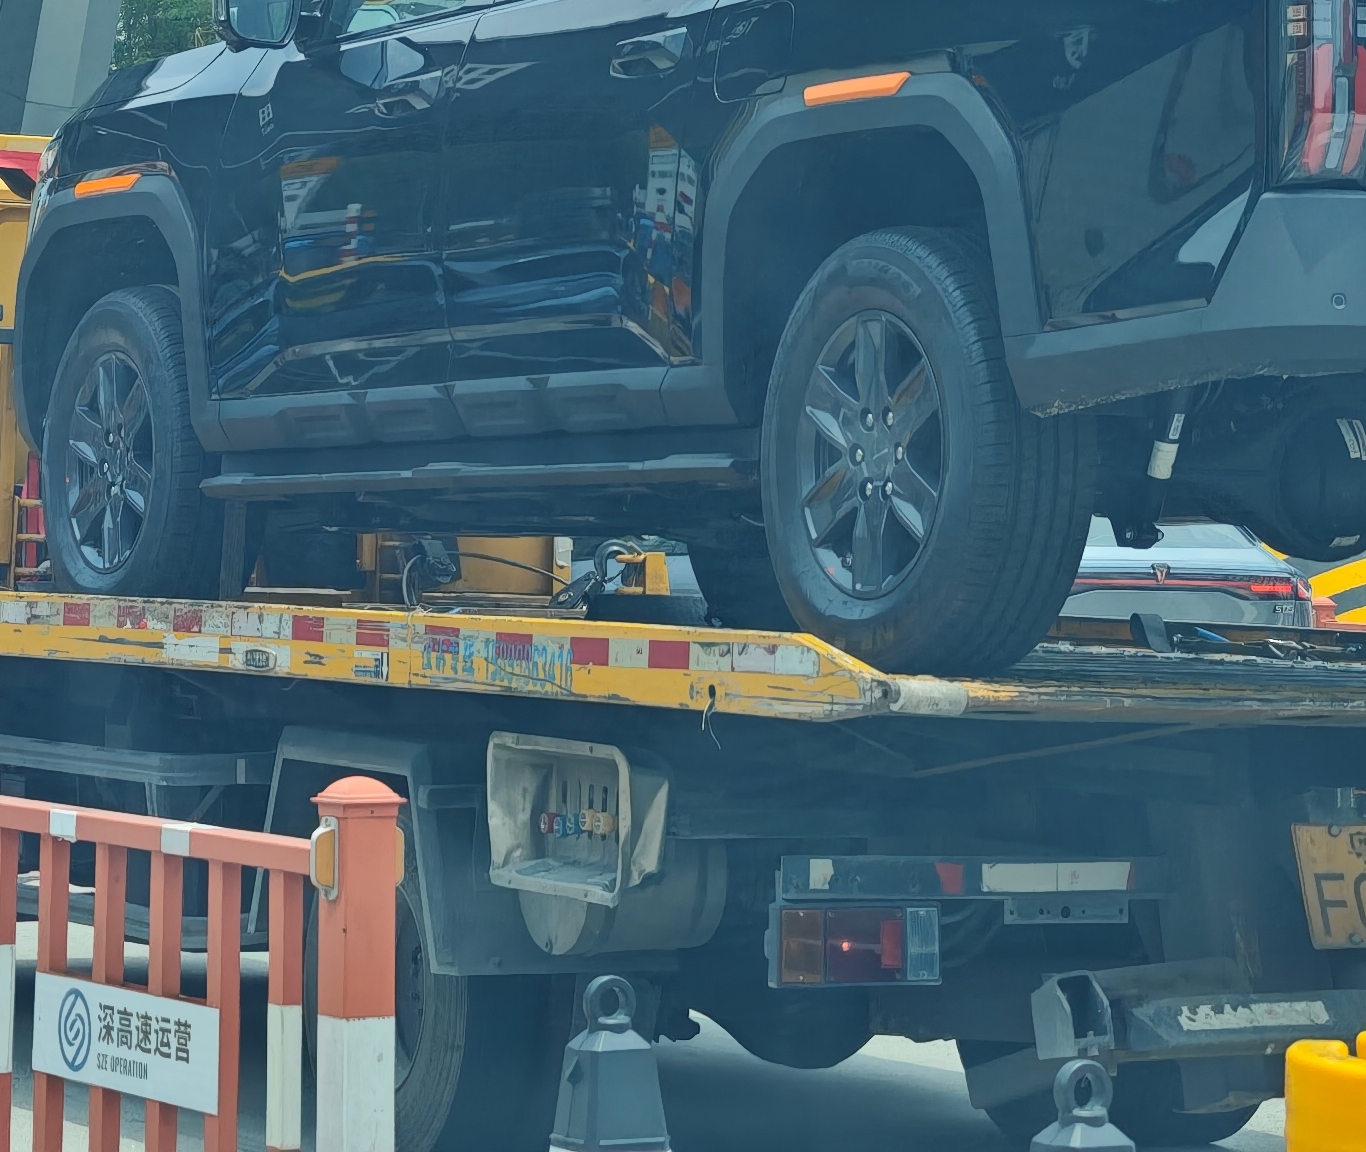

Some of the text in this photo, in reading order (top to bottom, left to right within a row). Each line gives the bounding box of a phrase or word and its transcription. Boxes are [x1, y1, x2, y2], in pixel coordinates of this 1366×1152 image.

[97, 1002, 191, 1064] 深高速运营
[96, 1053, 148, 1081] SZE OPERATION
